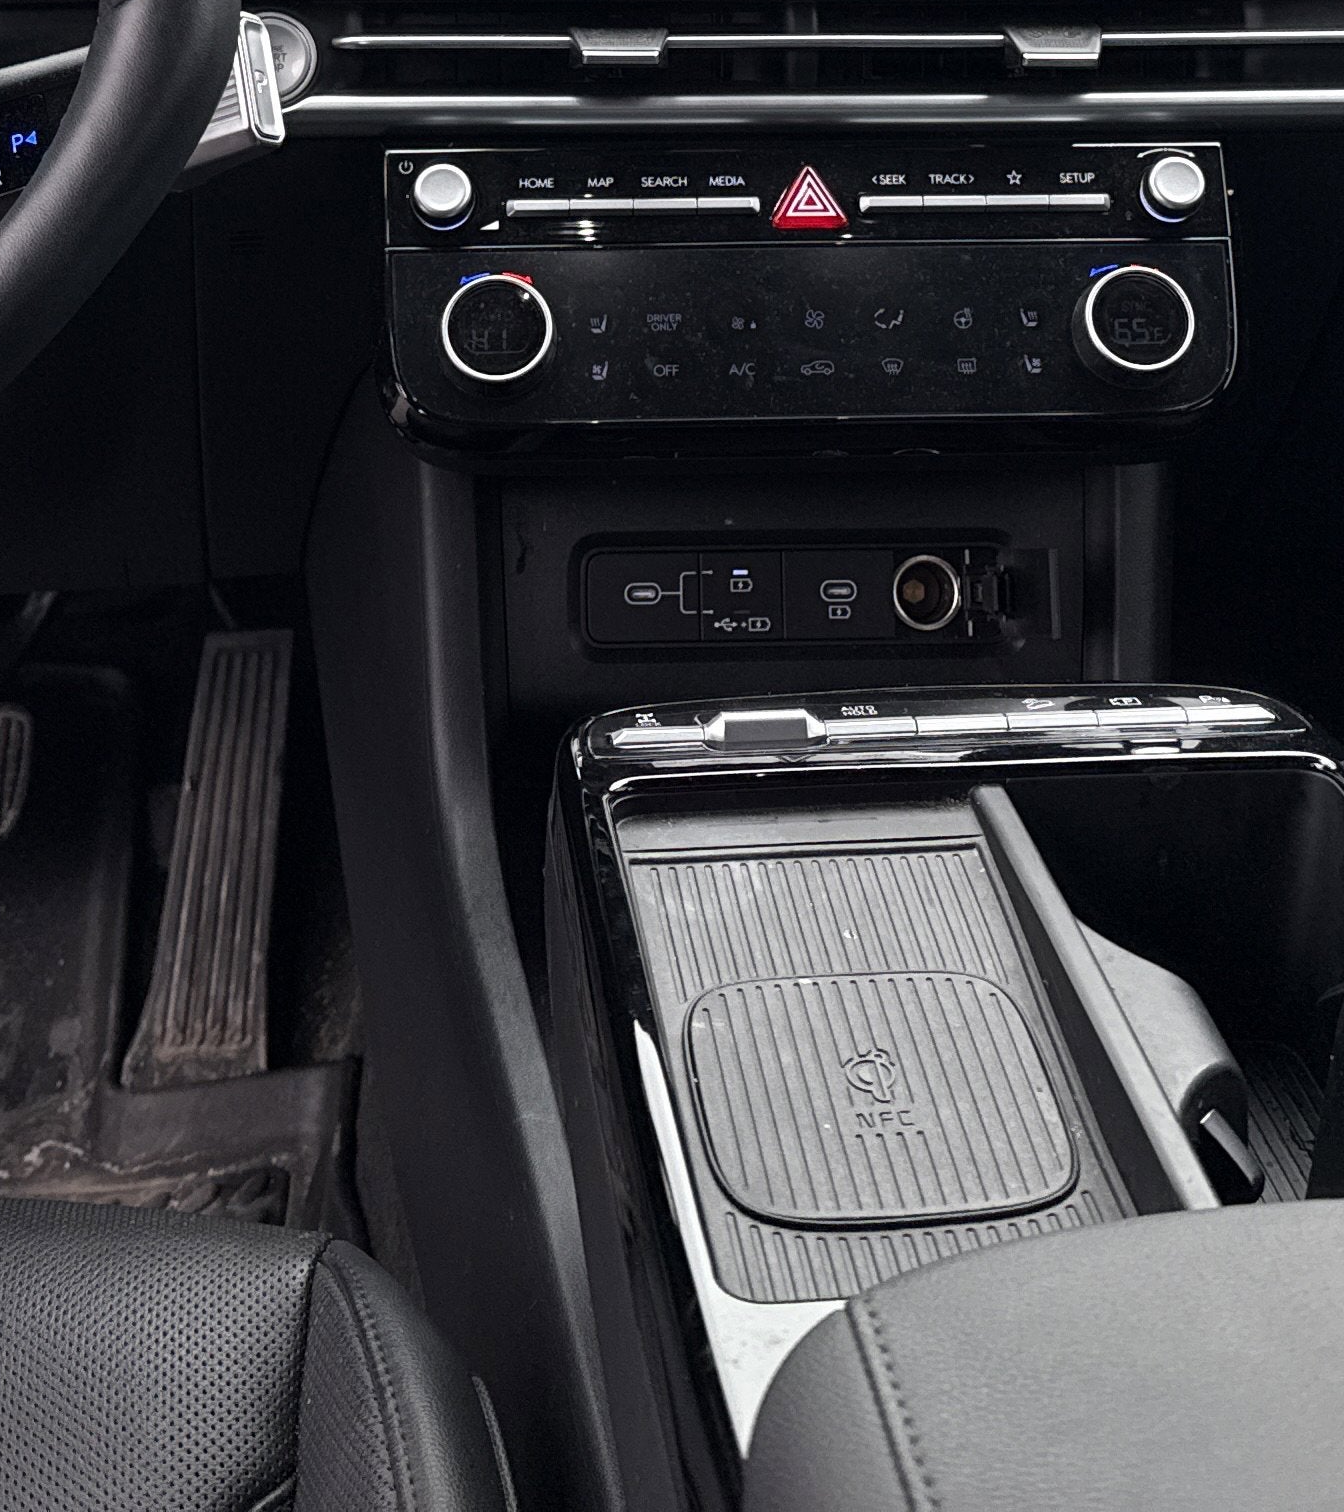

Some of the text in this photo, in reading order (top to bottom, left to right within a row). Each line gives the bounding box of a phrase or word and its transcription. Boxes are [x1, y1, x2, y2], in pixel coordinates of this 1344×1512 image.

[11, 133, 24, 153] P
[518, 178, 555, 188] HOME
[587, 177, 614, 188] MAP
[641, 176, 688, 187] SEARCH
[708, 176, 746, 187] MEDIA
[1059, 172, 1095, 184] SETUP
[646, 313, 682, 323] DRIVER
[650, 322, 678, 332] ONLY
[652, 363, 680, 377] OFF
[729, 363, 756, 377] A/C
[855, 1110, 915, 1128] NFC
